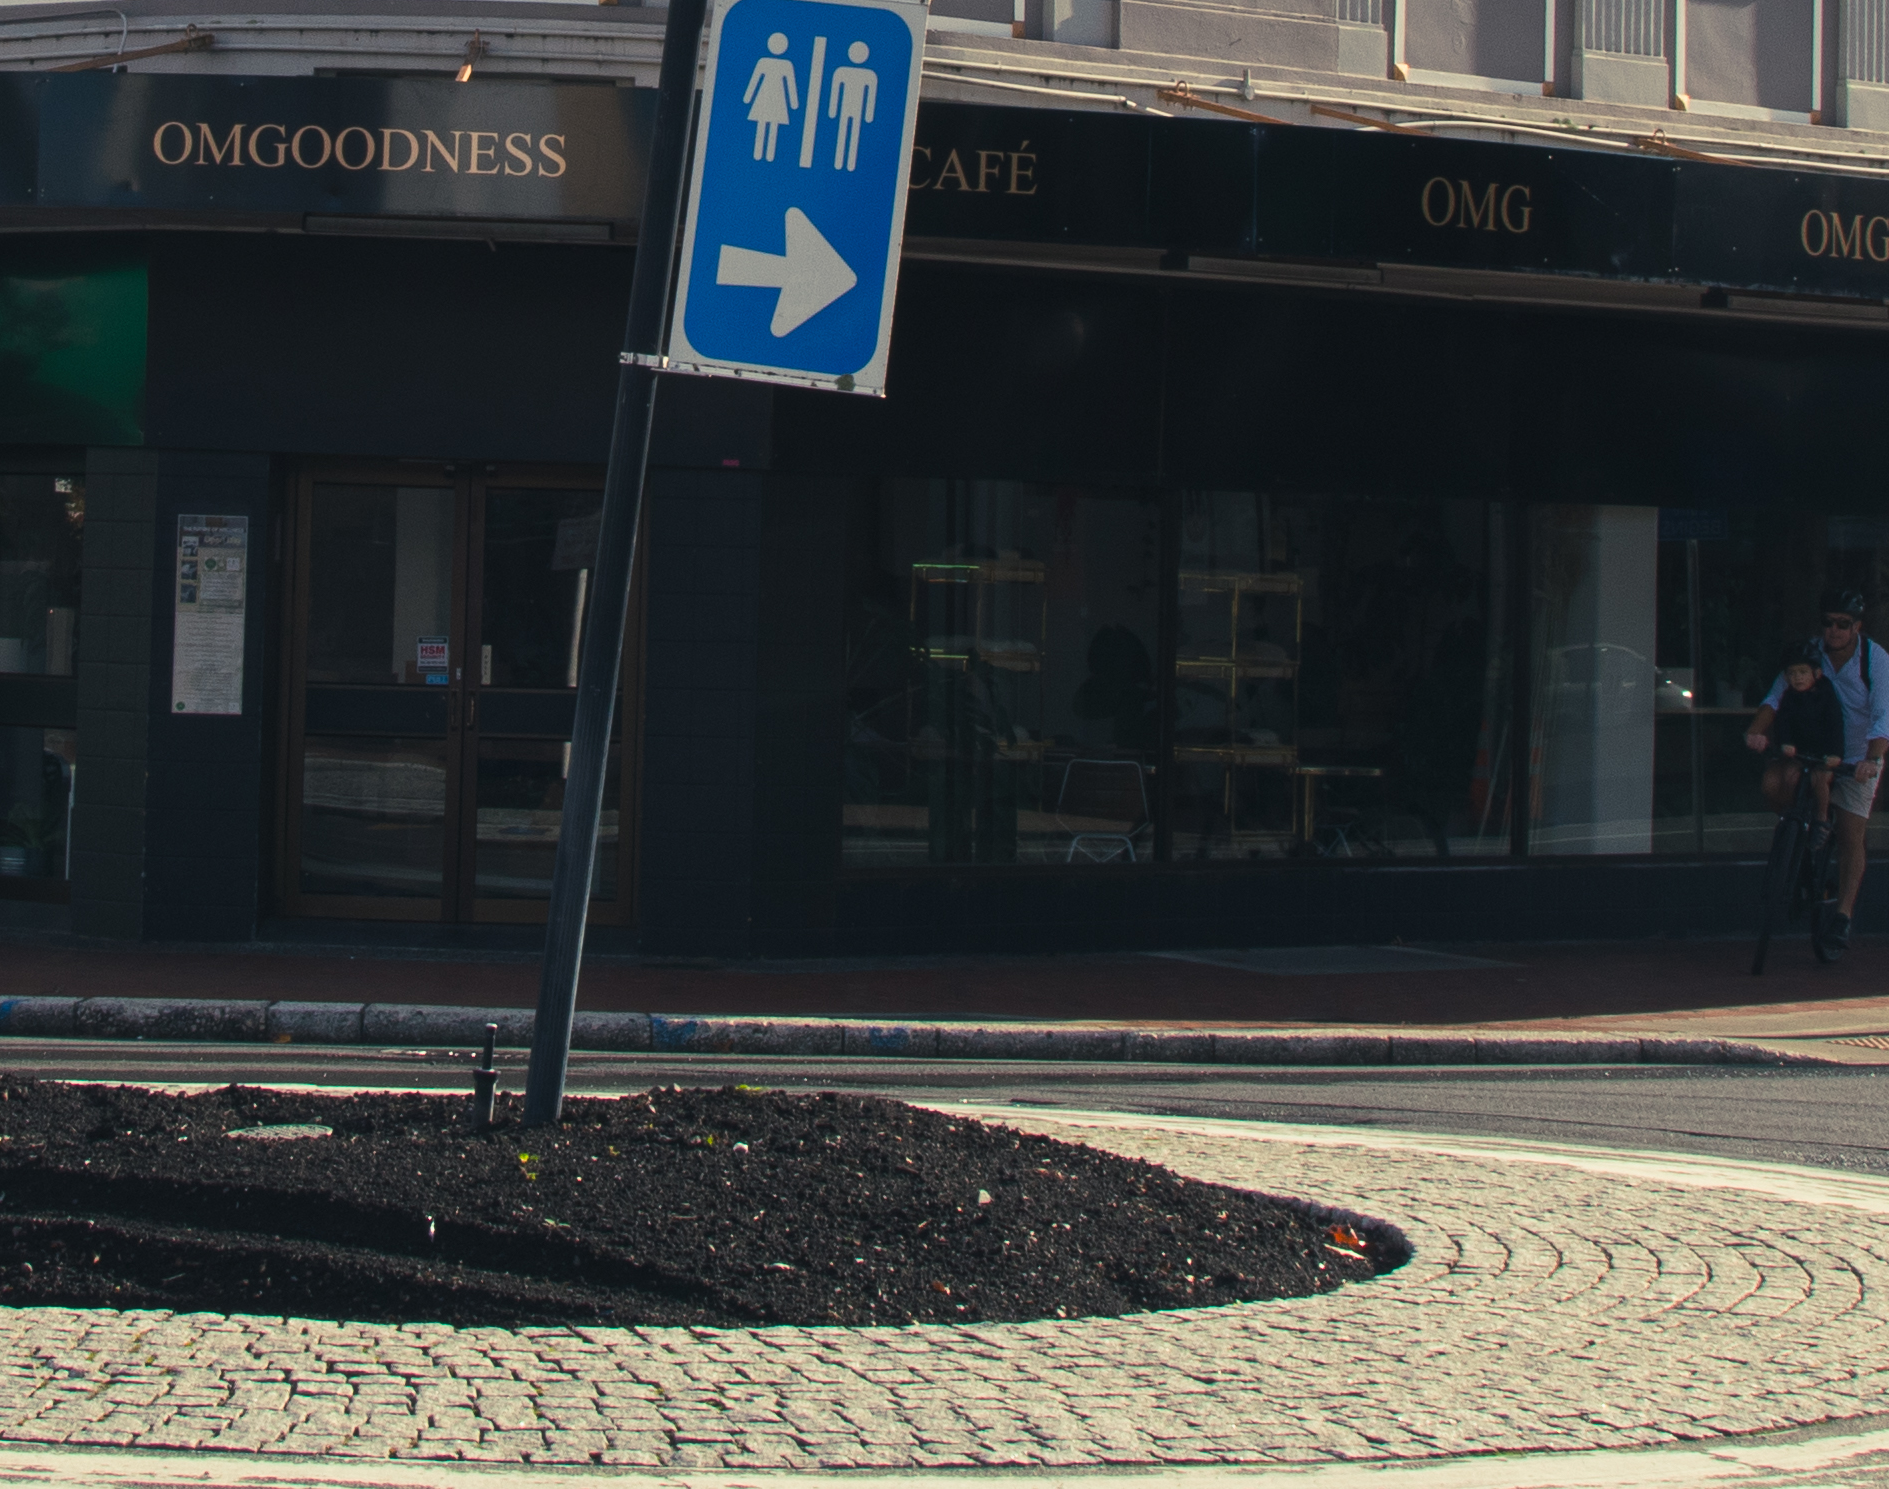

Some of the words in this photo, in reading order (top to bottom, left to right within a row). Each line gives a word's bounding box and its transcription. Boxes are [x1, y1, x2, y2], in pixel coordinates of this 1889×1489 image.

[152, 121, 567, 178] OMGOODNESS
[908, 140, 1038, 195] CAFÉ
[1421, 176, 1534, 234] OMG
[420, 646, 446, 655] HSM
